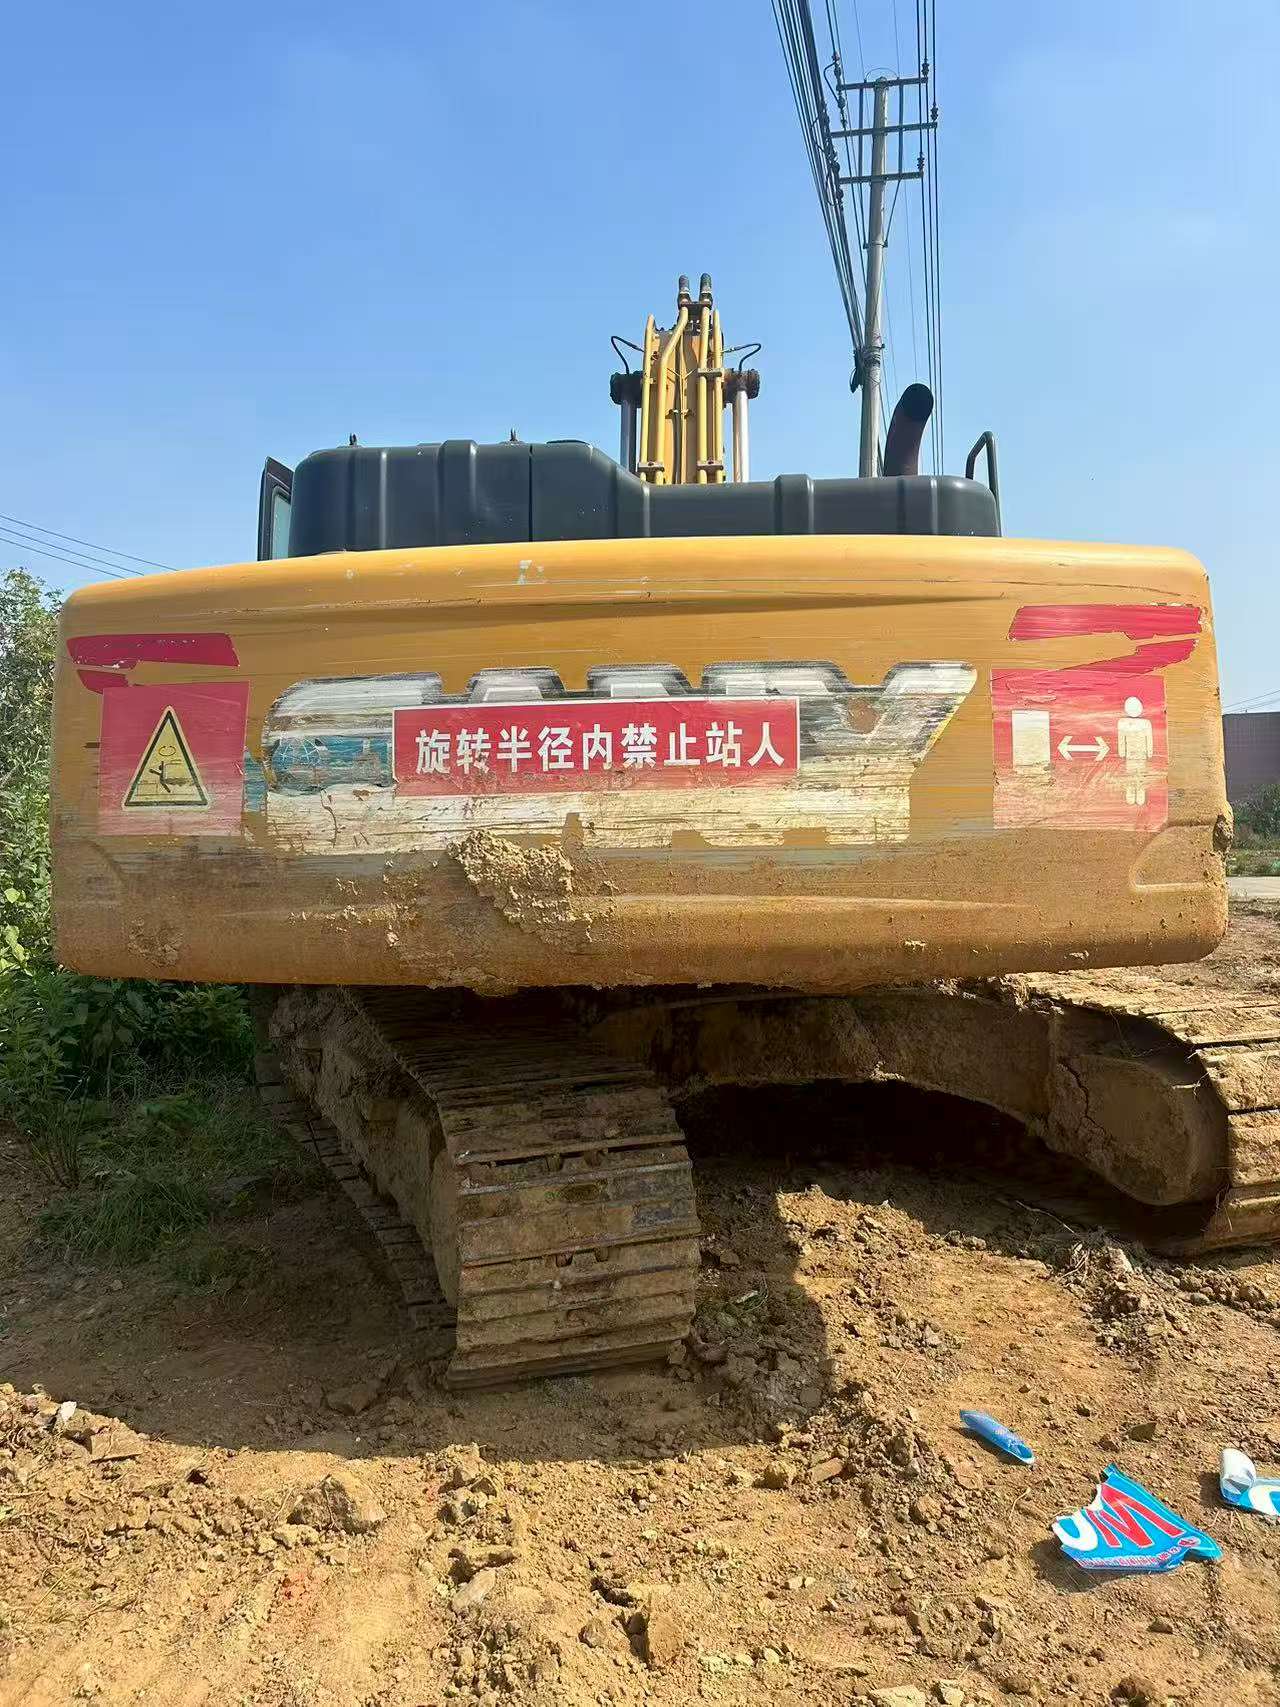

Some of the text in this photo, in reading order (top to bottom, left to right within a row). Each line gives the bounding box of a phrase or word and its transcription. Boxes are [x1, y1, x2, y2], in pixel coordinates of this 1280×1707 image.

[415, 721, 785, 775] 旋转半径内禁止站人
